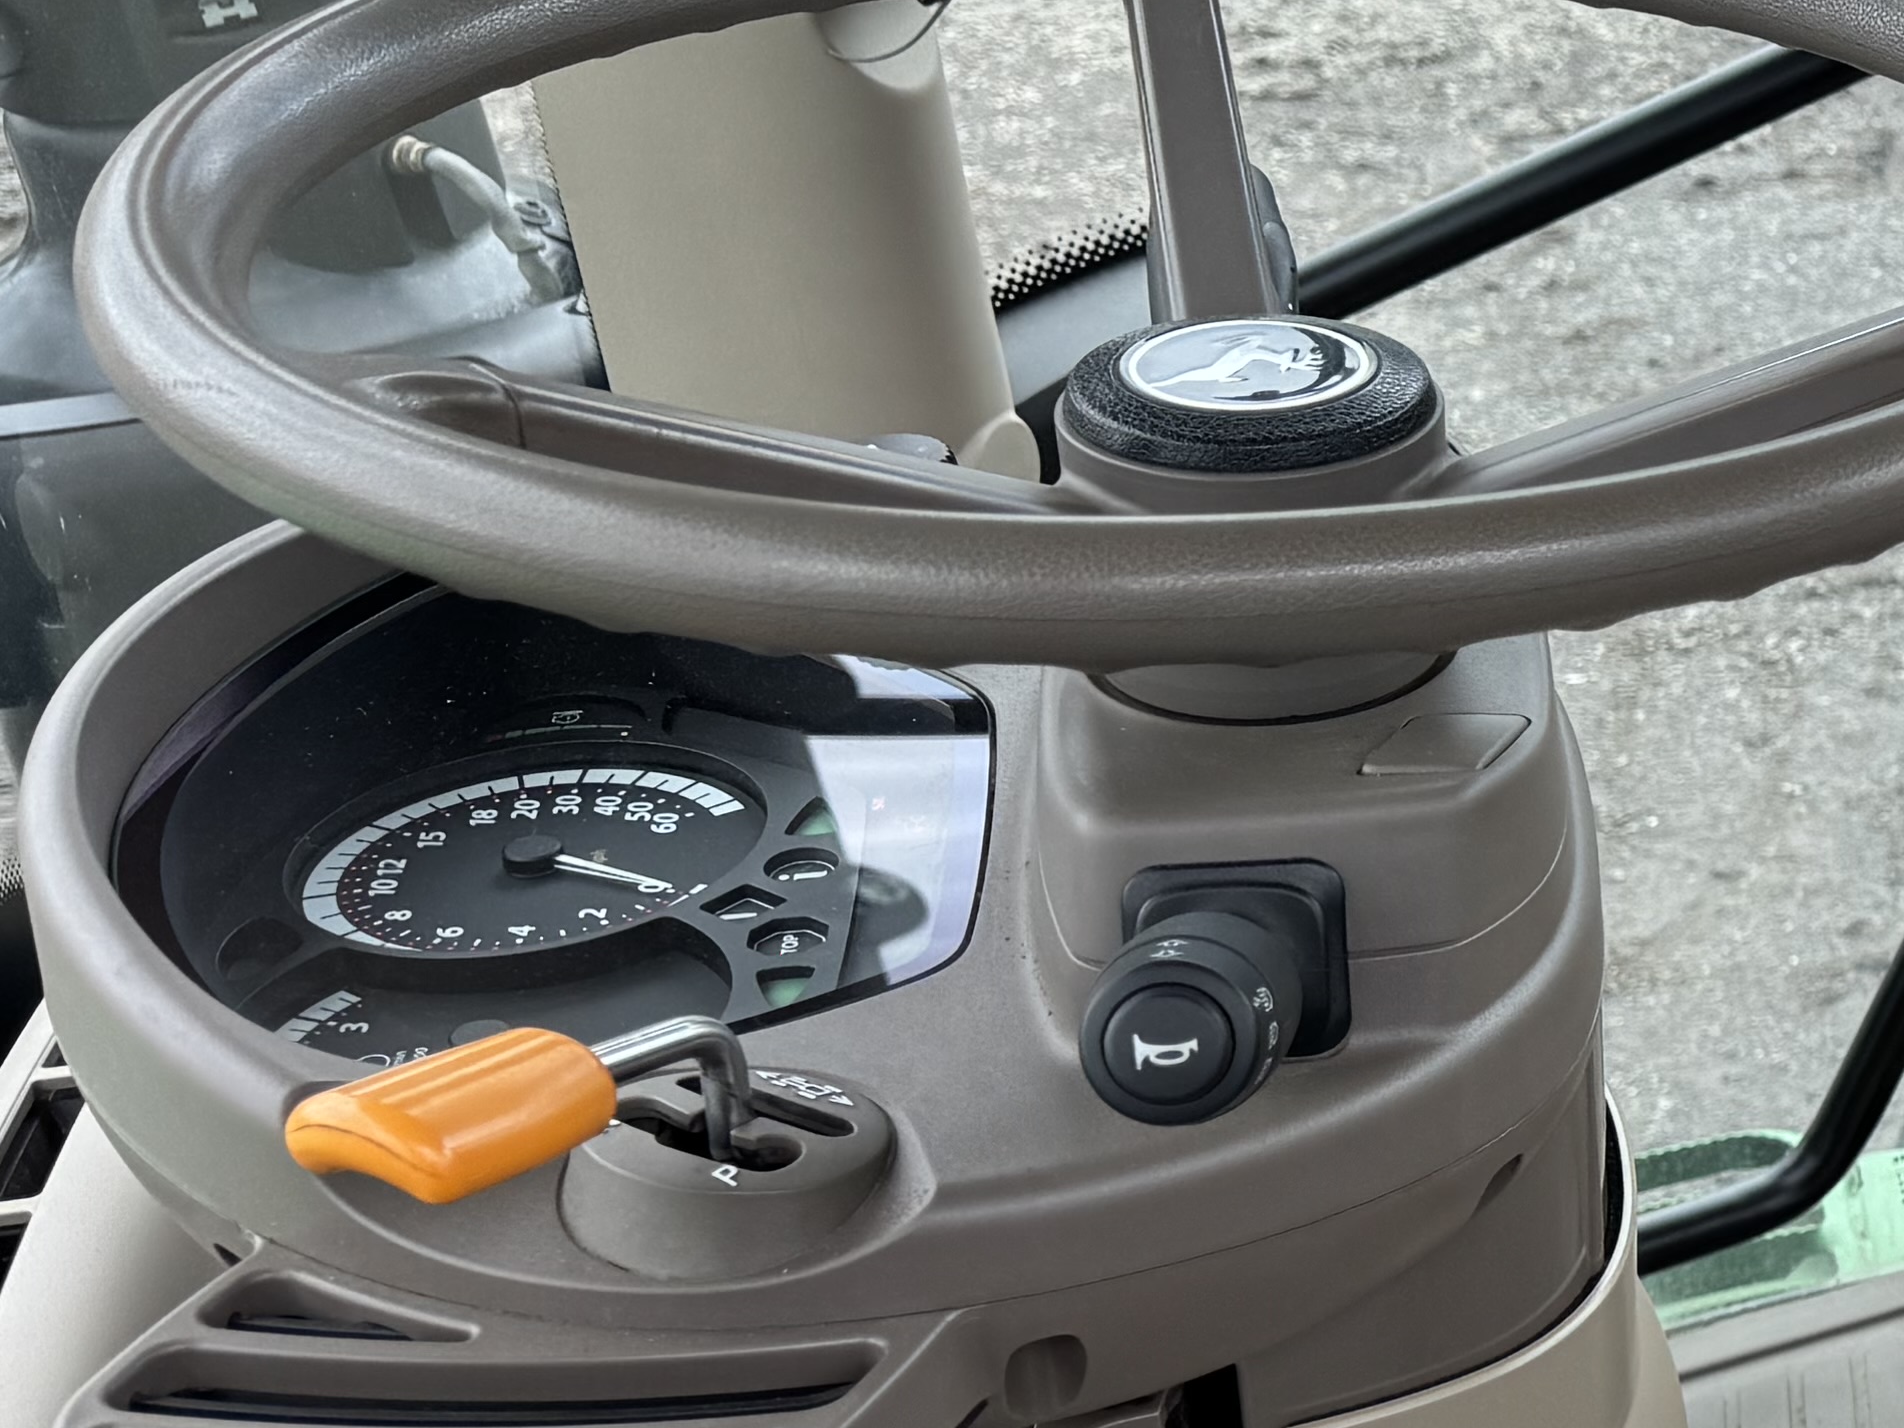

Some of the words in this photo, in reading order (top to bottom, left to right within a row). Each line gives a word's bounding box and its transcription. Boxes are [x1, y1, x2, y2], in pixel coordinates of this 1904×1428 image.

[510, 799, 541, 820] 20
[552, 794, 582, 815] 30
[593, 795, 623, 816] 40
[624, 801, 654, 822] 50
[469, 808, 499, 827] 18
[650, 812, 679, 834] 60
[416, 830, 447, 849] 15
[376, 858, 407, 876] 12
[368, 878, 399, 897] 10
[384, 909, 413, 921] 8
[578, 907, 608, 919] 2
[436, 926, 465, 938] 6
[507, 924, 536, 938] 4
[780, 934, 799, 956] TOP
[339, 1021, 369, 1034] 3
[711, 1163, 740, 1187] P
